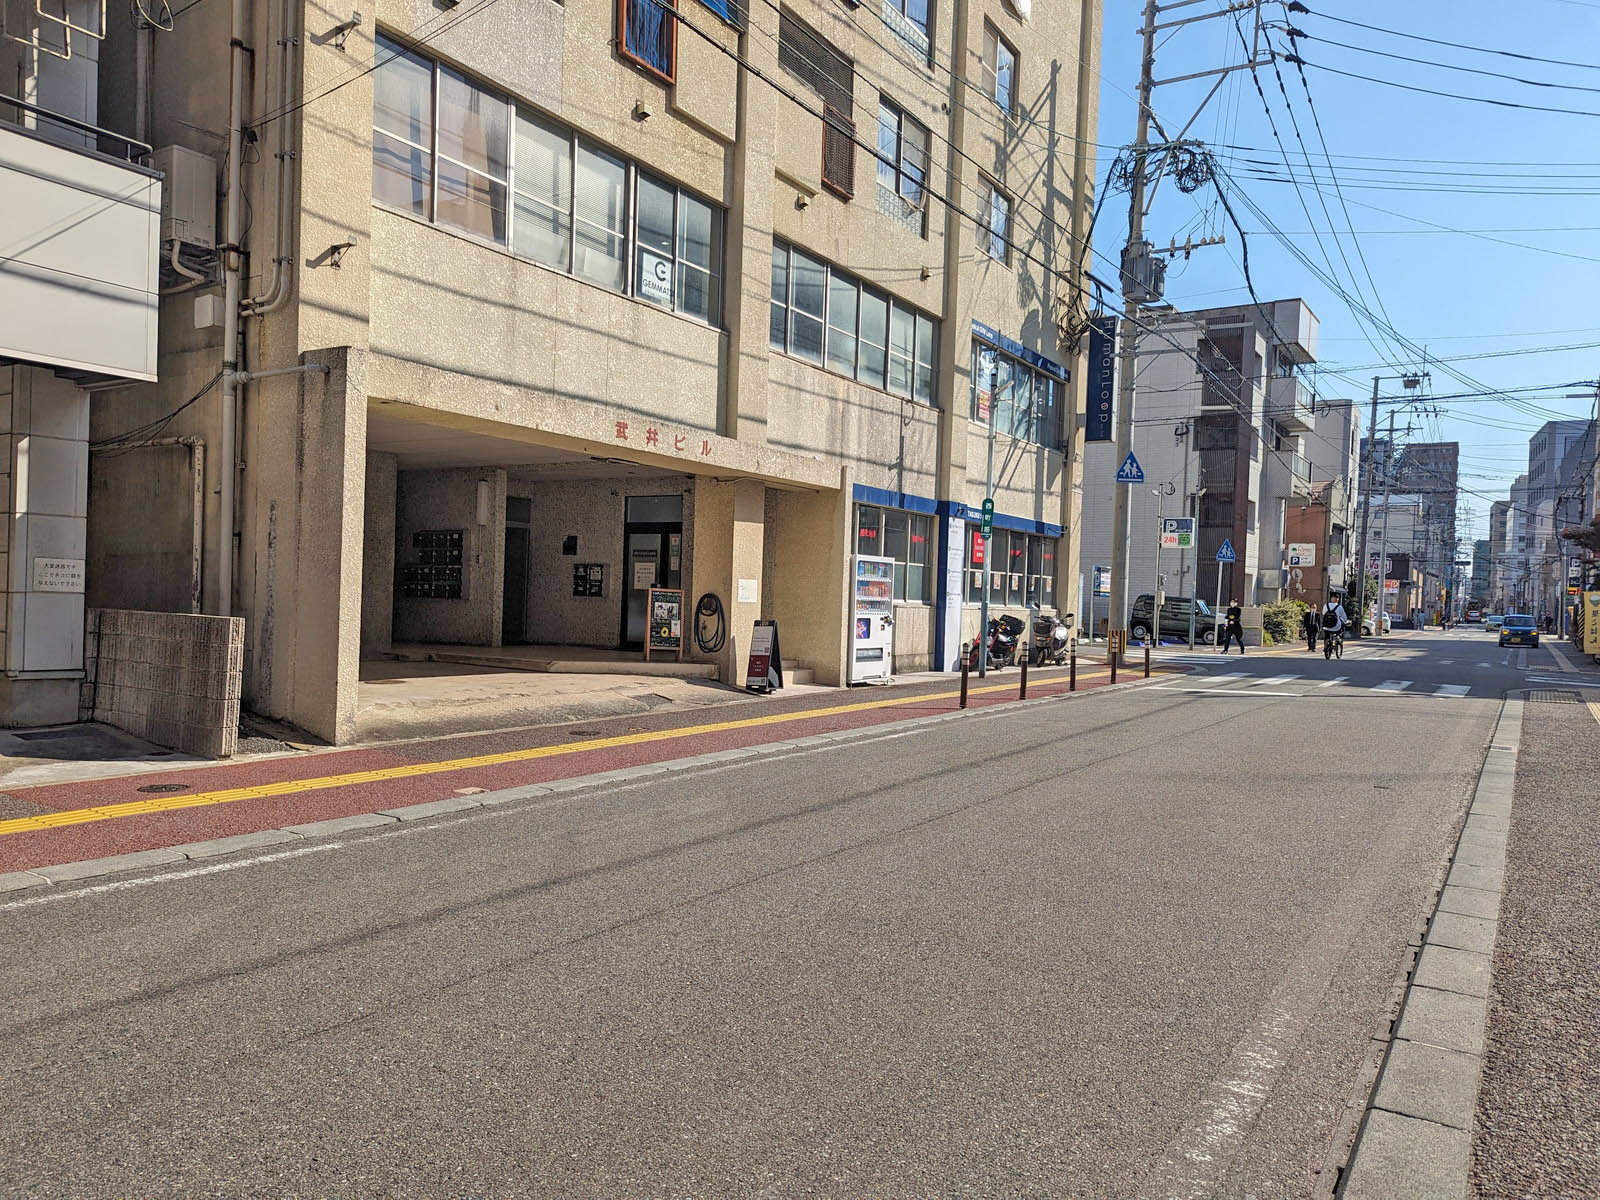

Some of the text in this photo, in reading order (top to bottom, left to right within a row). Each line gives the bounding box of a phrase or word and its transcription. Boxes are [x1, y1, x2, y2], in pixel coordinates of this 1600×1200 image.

[615, 420, 712, 457] 武井ビル
[1165, 519, 1178, 534] P
[1163, 536, 1177, 544] 24h
[1292, 557, 1299, 565] P
